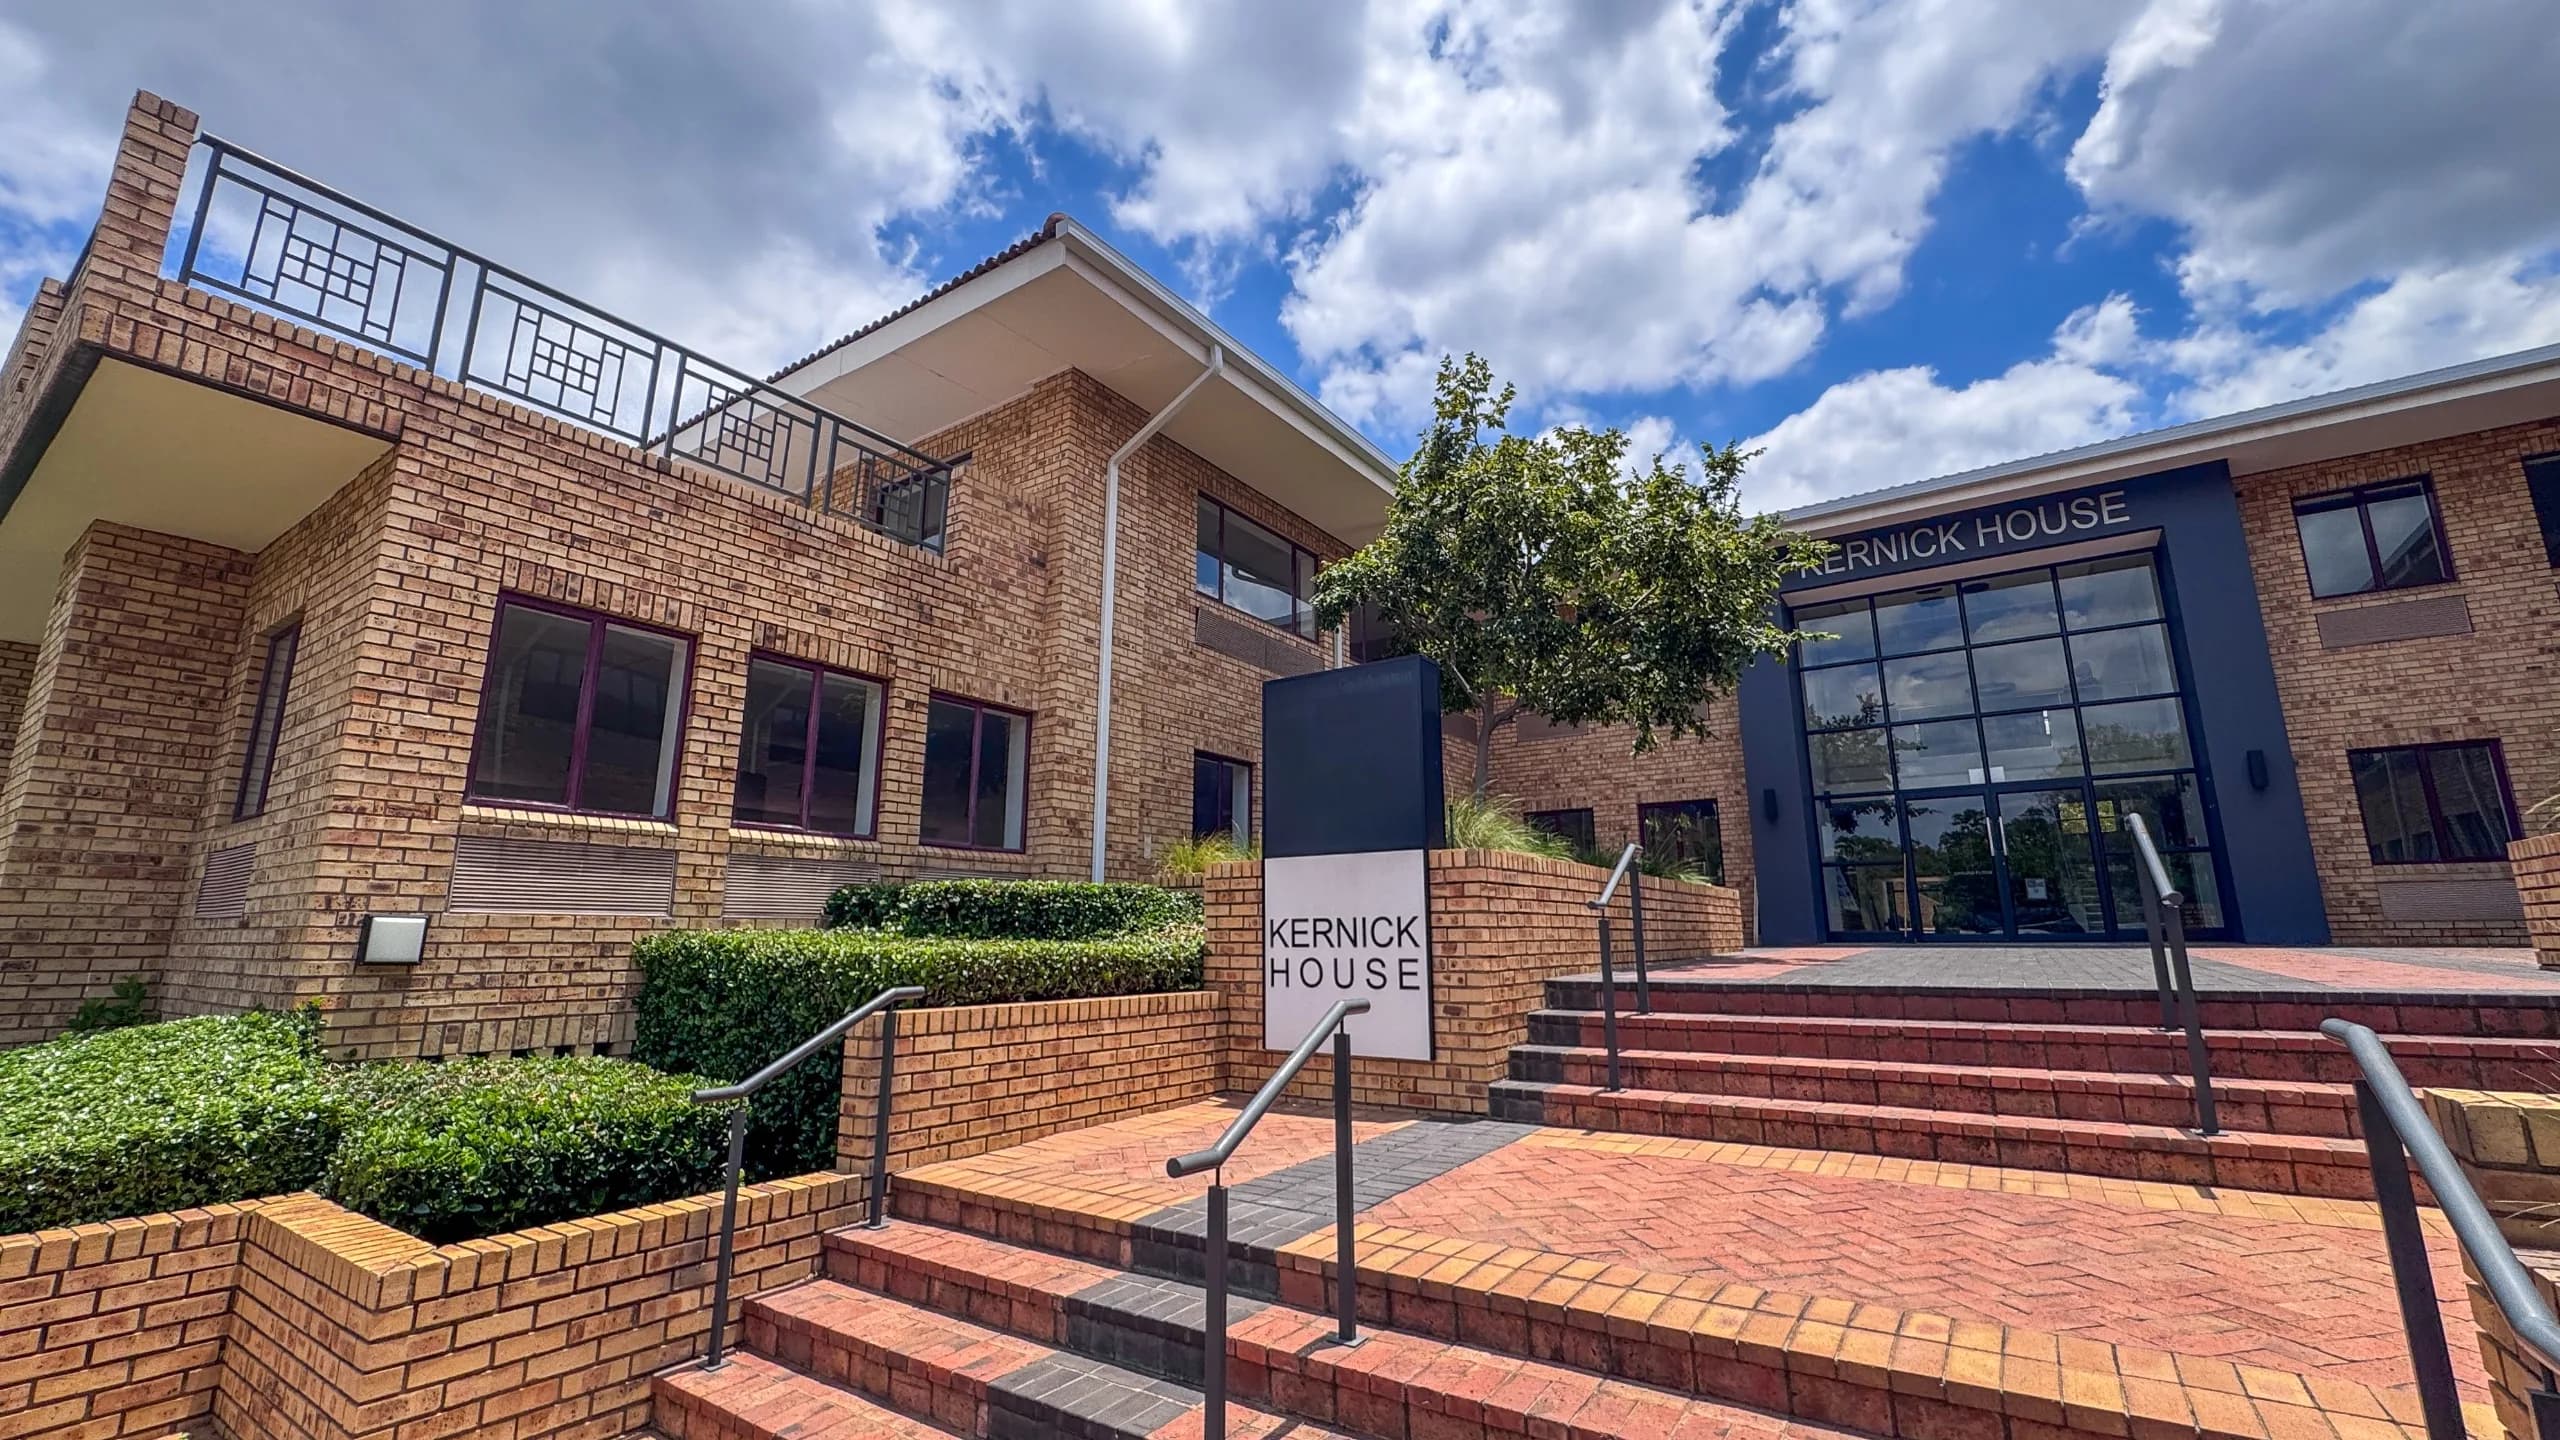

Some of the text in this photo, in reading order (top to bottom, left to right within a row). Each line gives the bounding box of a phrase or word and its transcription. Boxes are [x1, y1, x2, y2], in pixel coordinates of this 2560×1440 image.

[1975, 490, 2131, 547] HOUSE
[1270, 916, 1420, 948] KERNICK
[1270, 957, 1420, 990] HOUSE
